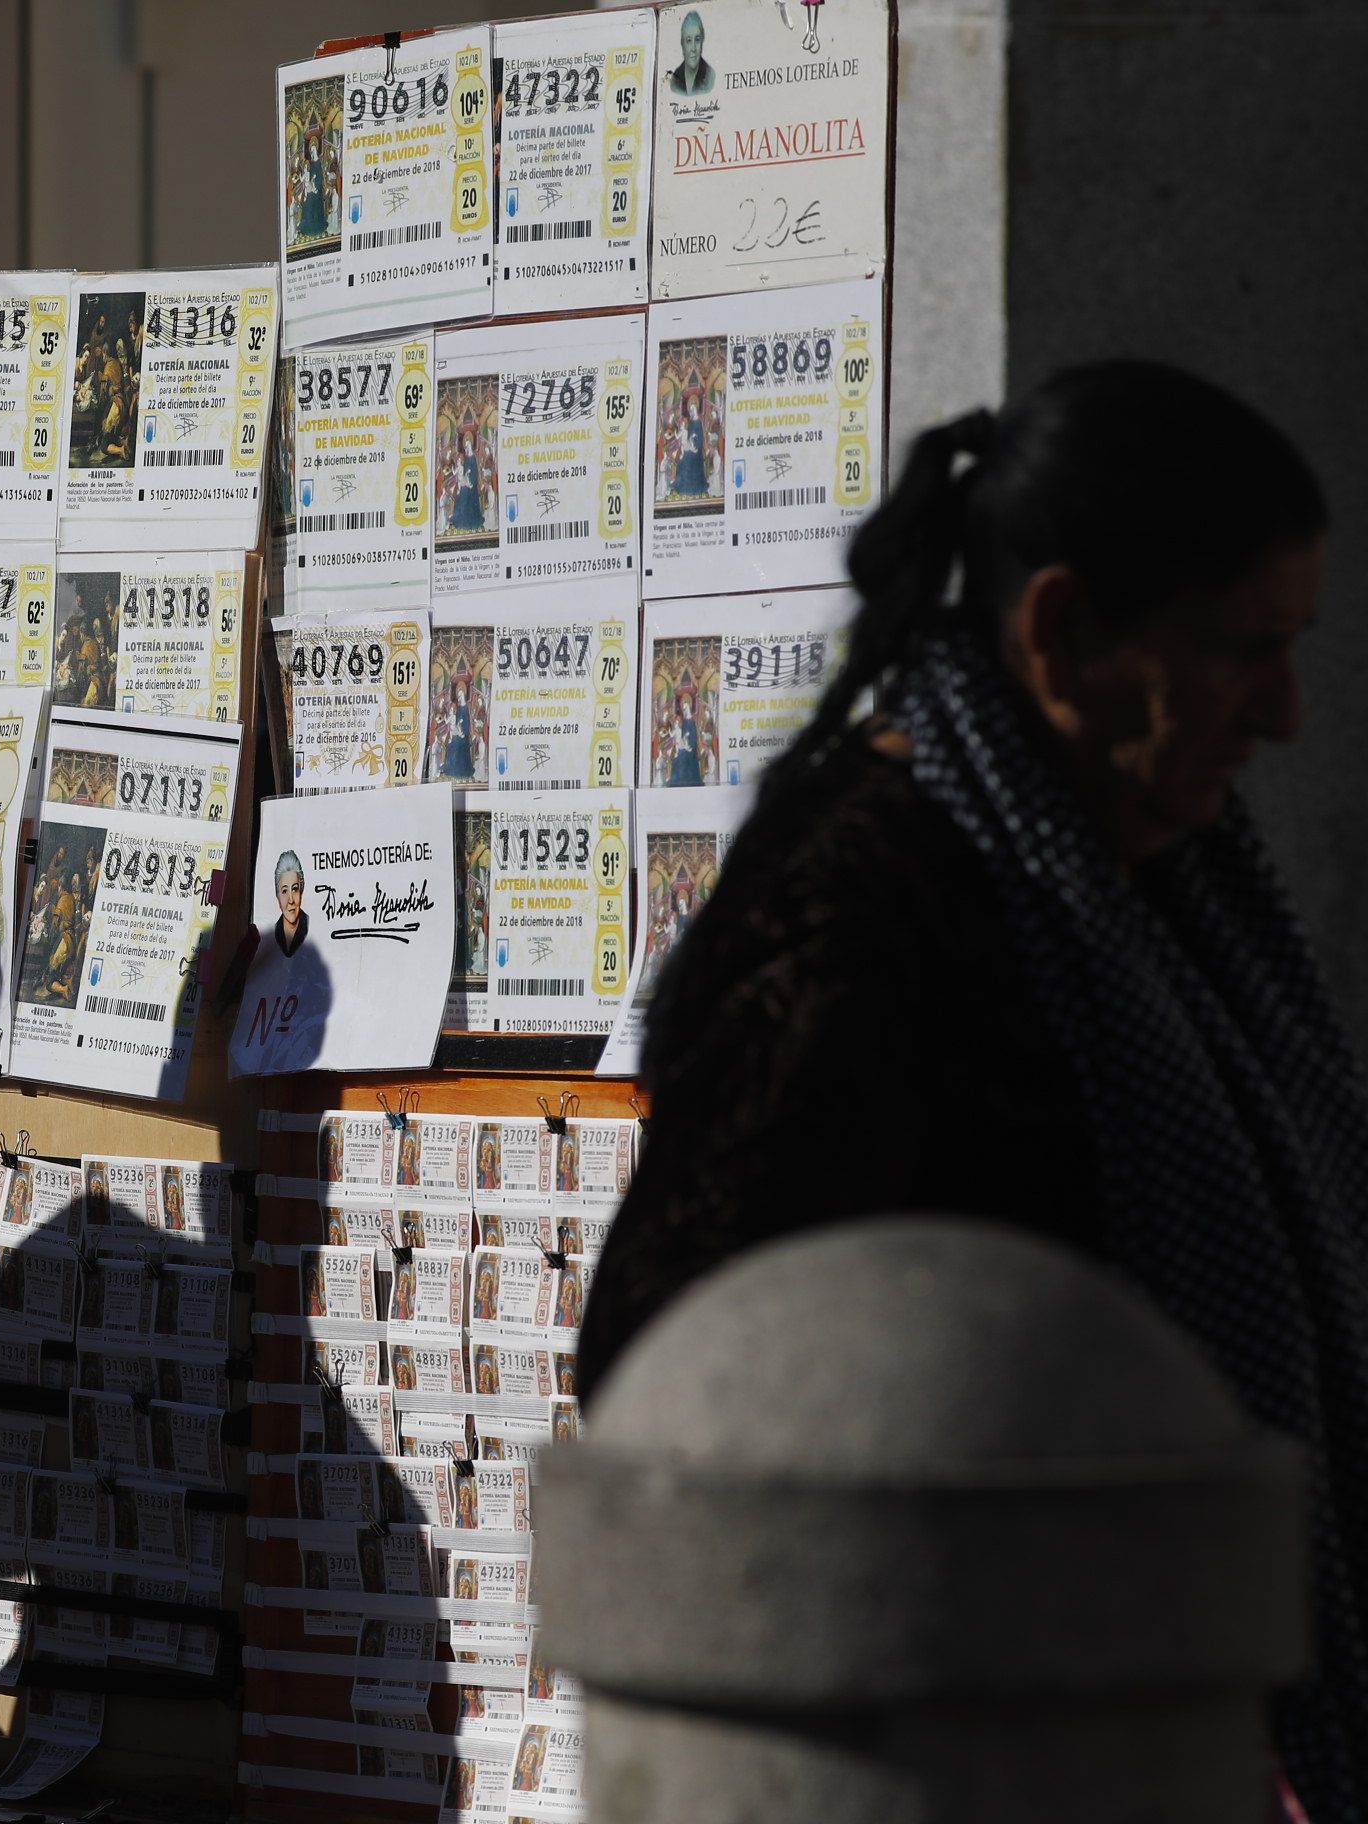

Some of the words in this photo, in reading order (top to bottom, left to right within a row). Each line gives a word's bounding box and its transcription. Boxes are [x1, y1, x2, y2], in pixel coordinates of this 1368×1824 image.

[458, 53, 479, 67] 102/18
[615, 53, 638, 64] 102/17
[725, 69, 782, 90] TENEMOS
[787, 57, 839, 83] LOTERÍA
[843, 58, 859, 77] DE
[505, 67, 600, 107] 47322
[349, 74, 449, 123] 90616
[347, 131, 392, 150] LOTERÍA
[396, 123, 447, 141] NACIONAL
[508, 125, 546, 141] LOTERÍA
[549, 124, 595, 137] NACIONAL
[517, 143, 537, 152] Décima
[539, 142, 555, 150] parte
[556, 140, 565, 148] del
[567, 139, 585, 147] billete
[364, 154, 379, 165] DE
[383, 144, 430, 162] NAVIDAD
[520, 154, 533, 164] para
[535, 153, 540, 162] el
[542, 153, 559, 163] sorteo
[561, 151, 570, 160] del
[510, 170, 517, 181] 22
[519, 169, 527, 180] de
[529, 167, 563, 179] diciembre
[565, 166, 573, 177] de
[576, 164, 591, 176] 2017
[462, 187, 477, 209] 20
[613, 191, 627, 211] 20
[660, 233, 717, 256] NÚMERO
[360, 256, 476, 284] 5102810104>0906161917
[516, 260, 623, 278] 5102706045>0473221517
[37, 302, 58, 311] 102/17
[147, 305, 236, 339] 41316
[149, 359, 184, 371] LOTERÍA
[187, 359, 230, 370] NACIONAL
[731, 338, 832, 379] 58869
[299, 363, 391, 404] 38577
[503, 375, 596, 415] 72765
[730, 396, 771, 412] LOTERÍA
[775, 393, 829, 408] NACIONAL
[0, 401, 15, 411] 2017
[298, 415, 338, 432] LOTERÍA
[341, 414, 391, 429] NACIONAL
[34, 429, 47, 446] 20
[242, 425, 255, 444] 20
[315, 437, 328, 449] DE
[331, 433, 374, 447] NAVIDAD
[502, 432, 542, 449] LOTERÍA
[545, 428, 592, 443] NACIONAL
[518, 454, 531, 465] DE
[533, 448, 576, 463] NAVIDAD
[508, 473, 516, 483] 22
[517, 472, 525, 482] de
[527, 469, 560, 481] diciembre
[561, 469, 569, 478] de
[571, 466, 587, 477] 2018
[150, 487, 248, 501] 5102709032>0413164102
[405, 482, 418, 502] 20
[608, 495, 621, 515] 20
[312, 549, 416, 567] 5102805069>0385774705
[123, 586, 210, 620] 41318
[293, 644, 383, 678] 40769
[498, 635, 589, 670] 50647
[726, 643, 824, 680] 39115
[335, 694, 379, 705] NACIONAL
[0, 723, 19, 737] 102/18
[120, 772, 202, 811] 07113
[499, 828, 589, 862] 11523
[312, 849, 364, 871] TENEMOS
[367, 841, 412, 866] LOTERÍA
[415, 842, 432, 861] DE:
[105, 848, 196, 891] 04913
[494, 876, 536, 891] LOTERÍA
[539, 879, 589, 890] NACIONAL
[101, 901, 138, 917] LOTERÍA
[142, 906, 184, 921] NACIONAL
[511, 898, 524, 909] DE
[527, 897, 572, 909] NAVIDAD
[603, 951, 616, 970] 20
[346, 1122, 381, 1136] 41316
[423, 1123, 457, 1141] 41316
[503, 1129, 537, 1143] 37072
[582, 1129, 616, 1144] 37072
[35, 1169, 70, 1188] 41314
[110, 1169, 144, 1183] 95236
[185, 1172, 219, 1187] 95236
[347, 1214, 380, 1227] 41316
[425, 1218, 457, 1231] 41316
[504, 1220, 538, 1235] 37072
[326, 1259, 358, 1272] 55267
[417, 1261, 448, 1275] 48837
[502, 1260, 539, 1275] 31108
[331, 1350, 363, 1363] 55267
[416, 1352, 448, 1366] 48837
[500, 1353, 534, 1367] 31108
[346, 1399, 378, 1410] 04134
[402, 1470, 433, 1483] 37072
[478, 1472, 512, 1486] 47322
[481, 1566, 515, 1579] 47322
